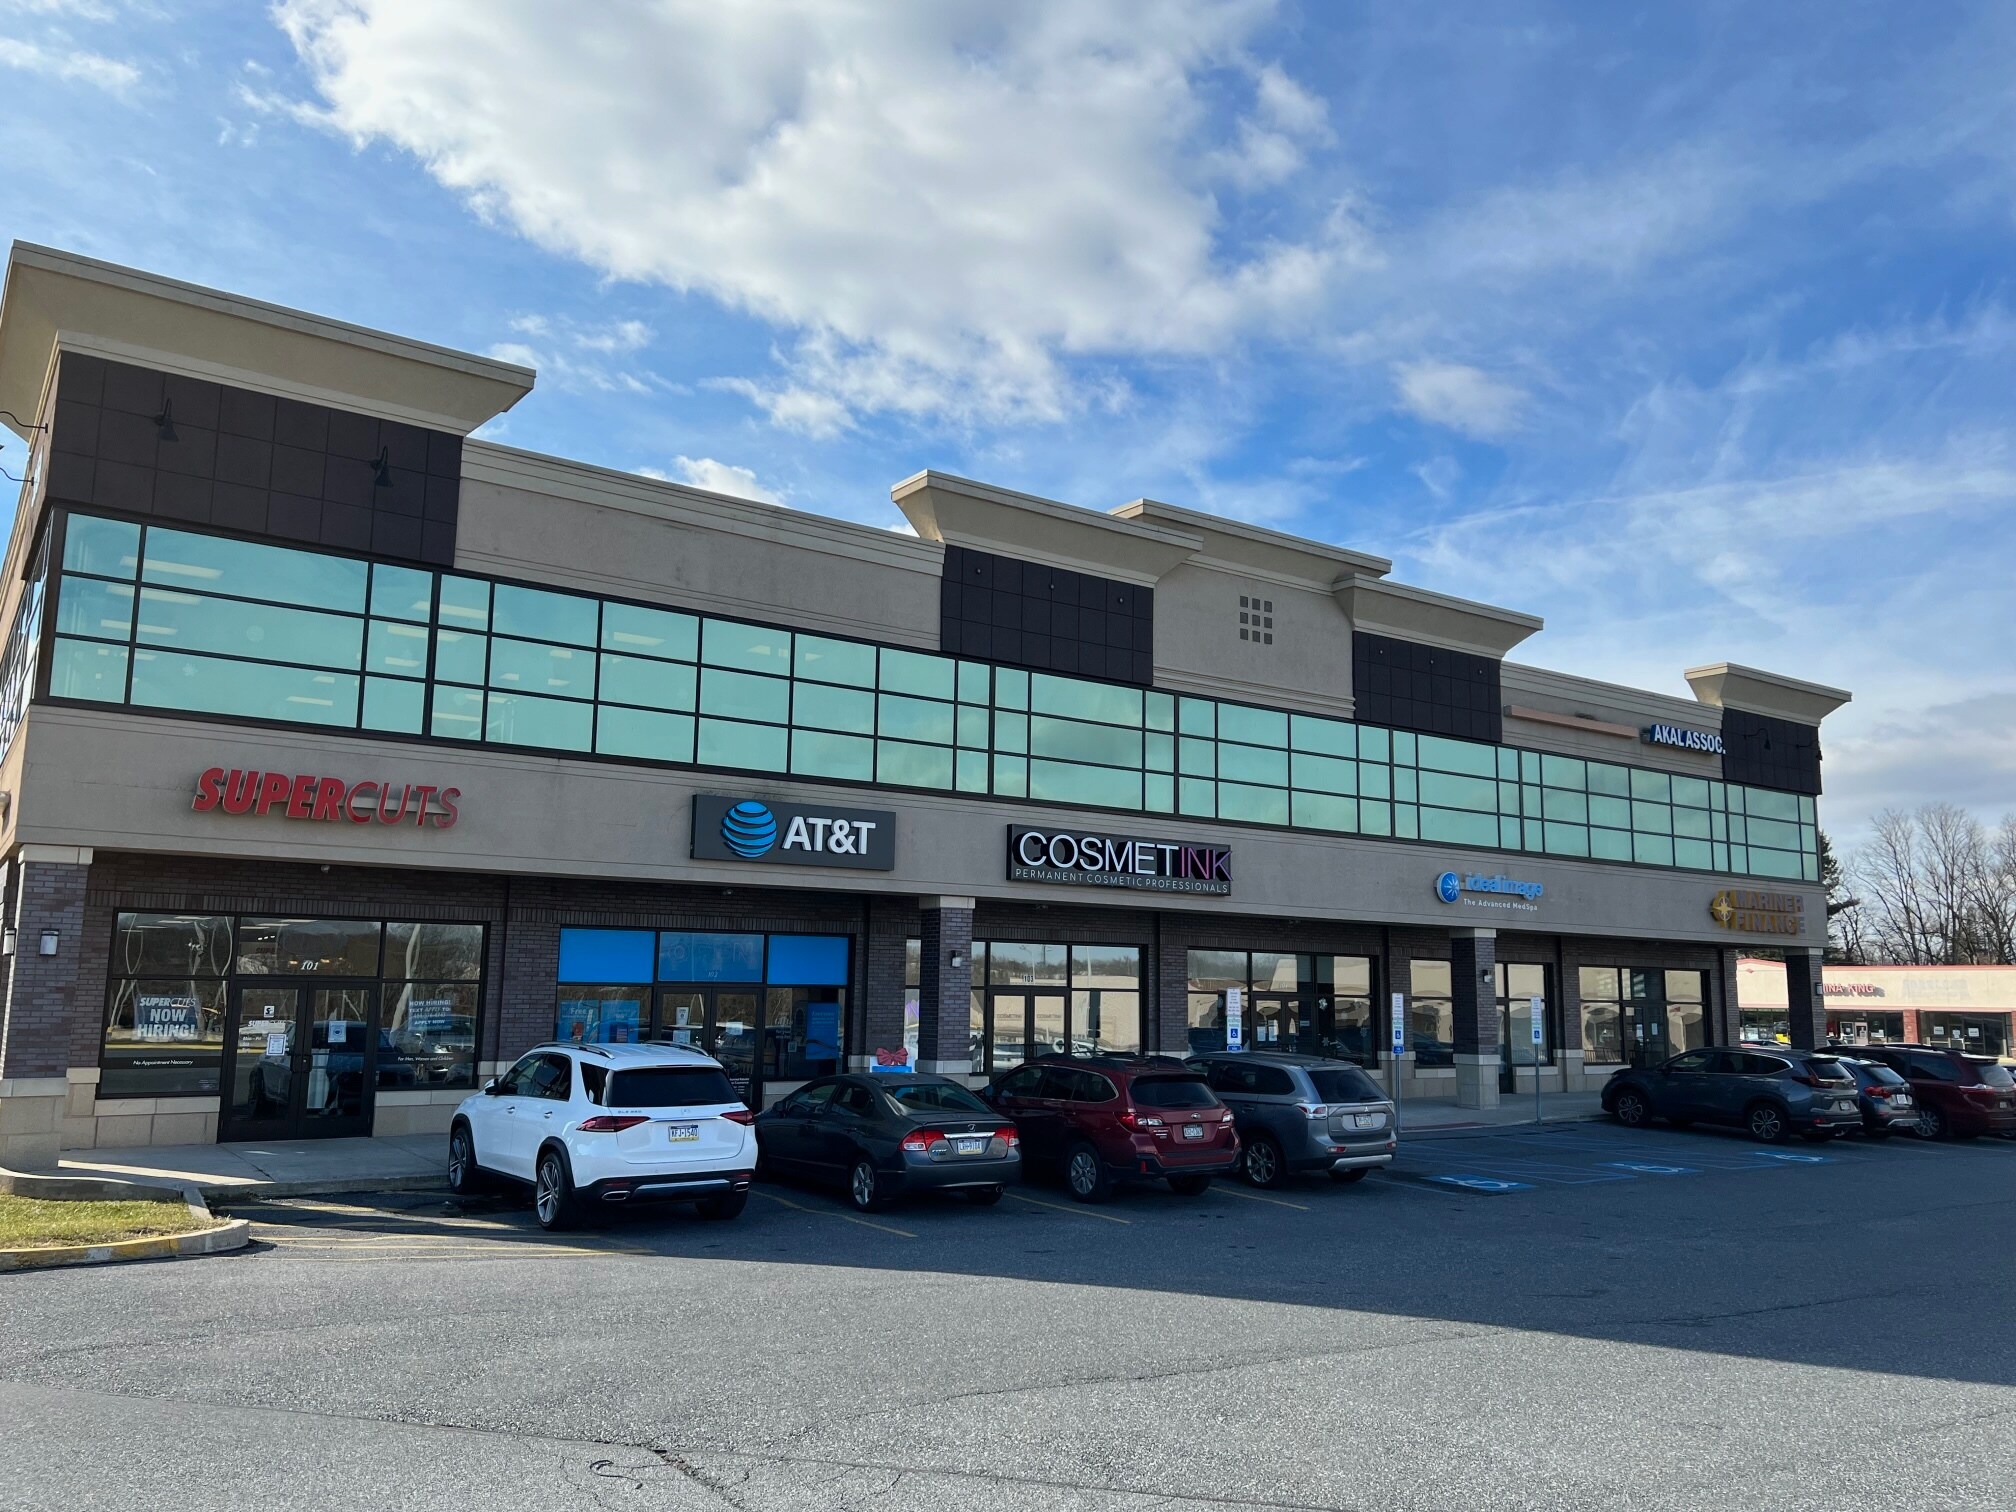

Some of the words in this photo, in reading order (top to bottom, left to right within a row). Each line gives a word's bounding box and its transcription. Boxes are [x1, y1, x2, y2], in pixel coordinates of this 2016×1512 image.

[1654, 724, 1685, 747] AKAL
[1685, 730, 1727, 755] ASSOC.
[192, 767, 462, 829] SUPERCUTS
[781, 816, 876, 855] AT&T
[1019, 831, 1233, 882] COSMETINK
[1015, 868, 1083, 883] PERMANENT
[1086, 874, 1143, 887] COSMETIC
[1145, 879, 1229, 894] PROFESSIONALS
[1463, 898, 1476, 907] The
[1478, 900, 1511, 909] Advanced
[1512, 902, 1539, 912] MedSpa
[301, 960, 319, 970] 101
[1848, 984, 1874, 993] KING
[139, 998, 196, 1007] SUPERCUTS
[150, 1008, 187, 1021] NOW
[137, 1024, 195, 1037] HIRING!
